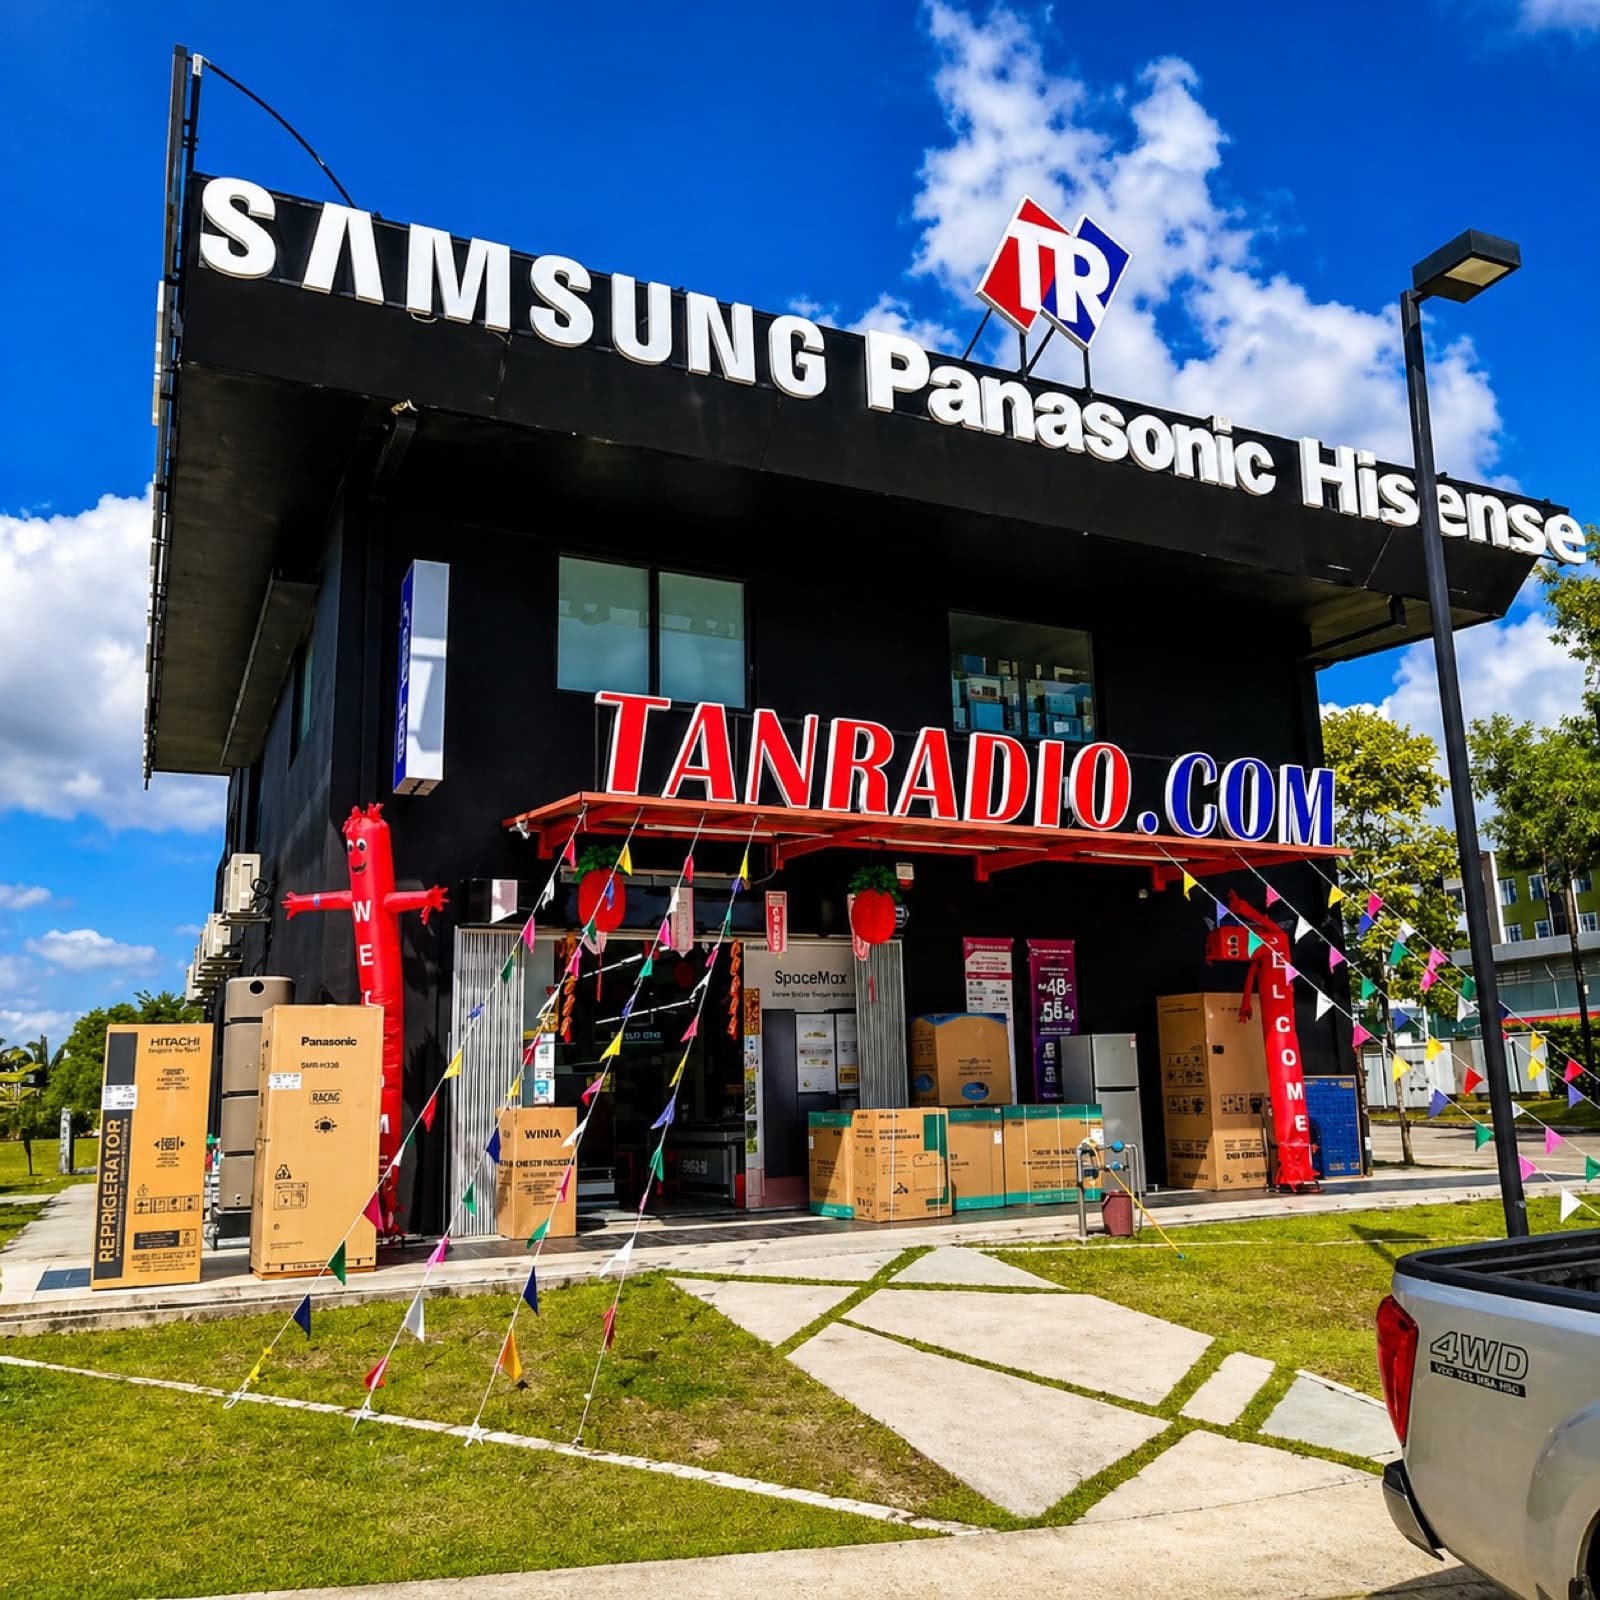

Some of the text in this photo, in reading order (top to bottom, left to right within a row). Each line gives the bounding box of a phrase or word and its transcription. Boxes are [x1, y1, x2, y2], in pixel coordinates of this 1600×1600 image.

[1007, 218, 1105, 329] TR
[199, 176, 1586, 564] SAMSUNG Panasonic Hisense
[150, 1036, 201, 1047] HITACHI
[301, 1036, 357, 1047] Panasonic
[525, 1129, 561, 1139] WINIA
[1430, 1331, 1529, 1380] 4WD
